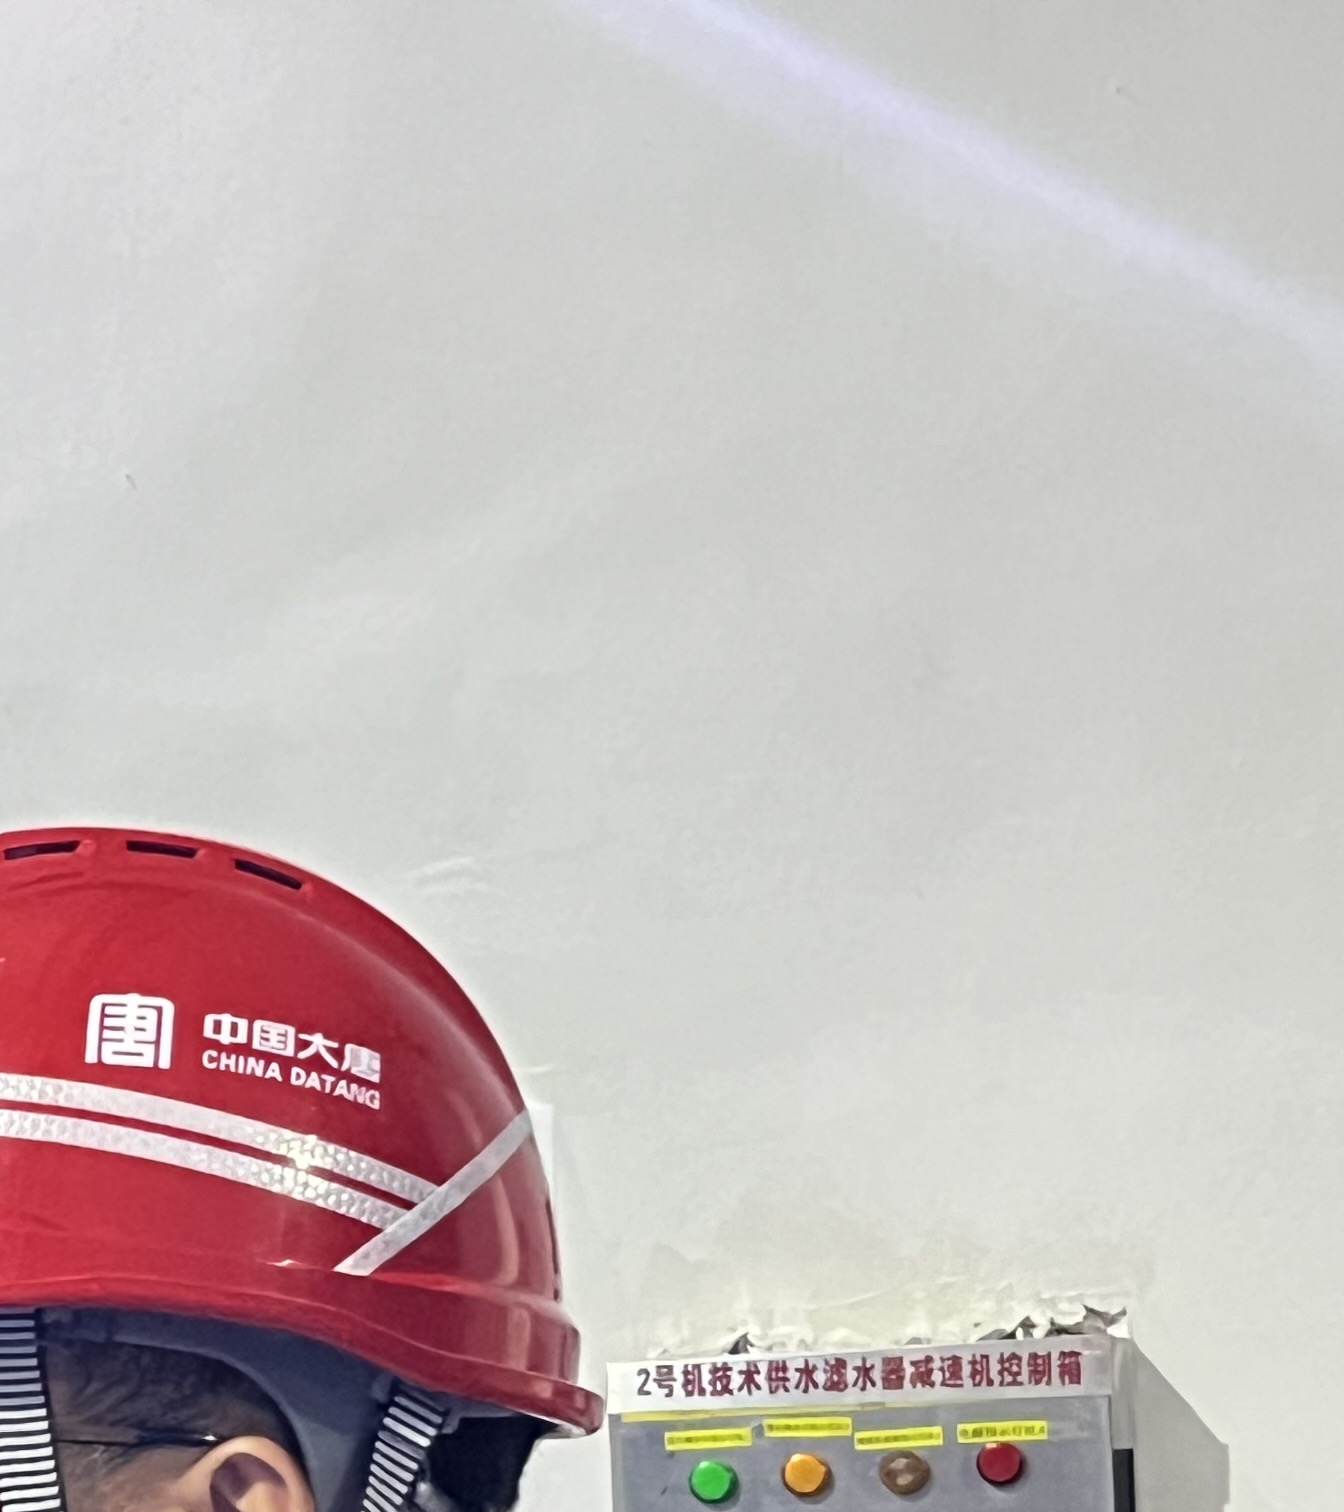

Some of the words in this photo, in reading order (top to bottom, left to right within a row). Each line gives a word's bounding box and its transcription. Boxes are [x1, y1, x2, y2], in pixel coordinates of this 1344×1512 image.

[201, 1049, 283, 1083] CHINA
[289, 1066, 381, 1111] DATANG
[202, 1012, 381, 1085] 中国大唐
